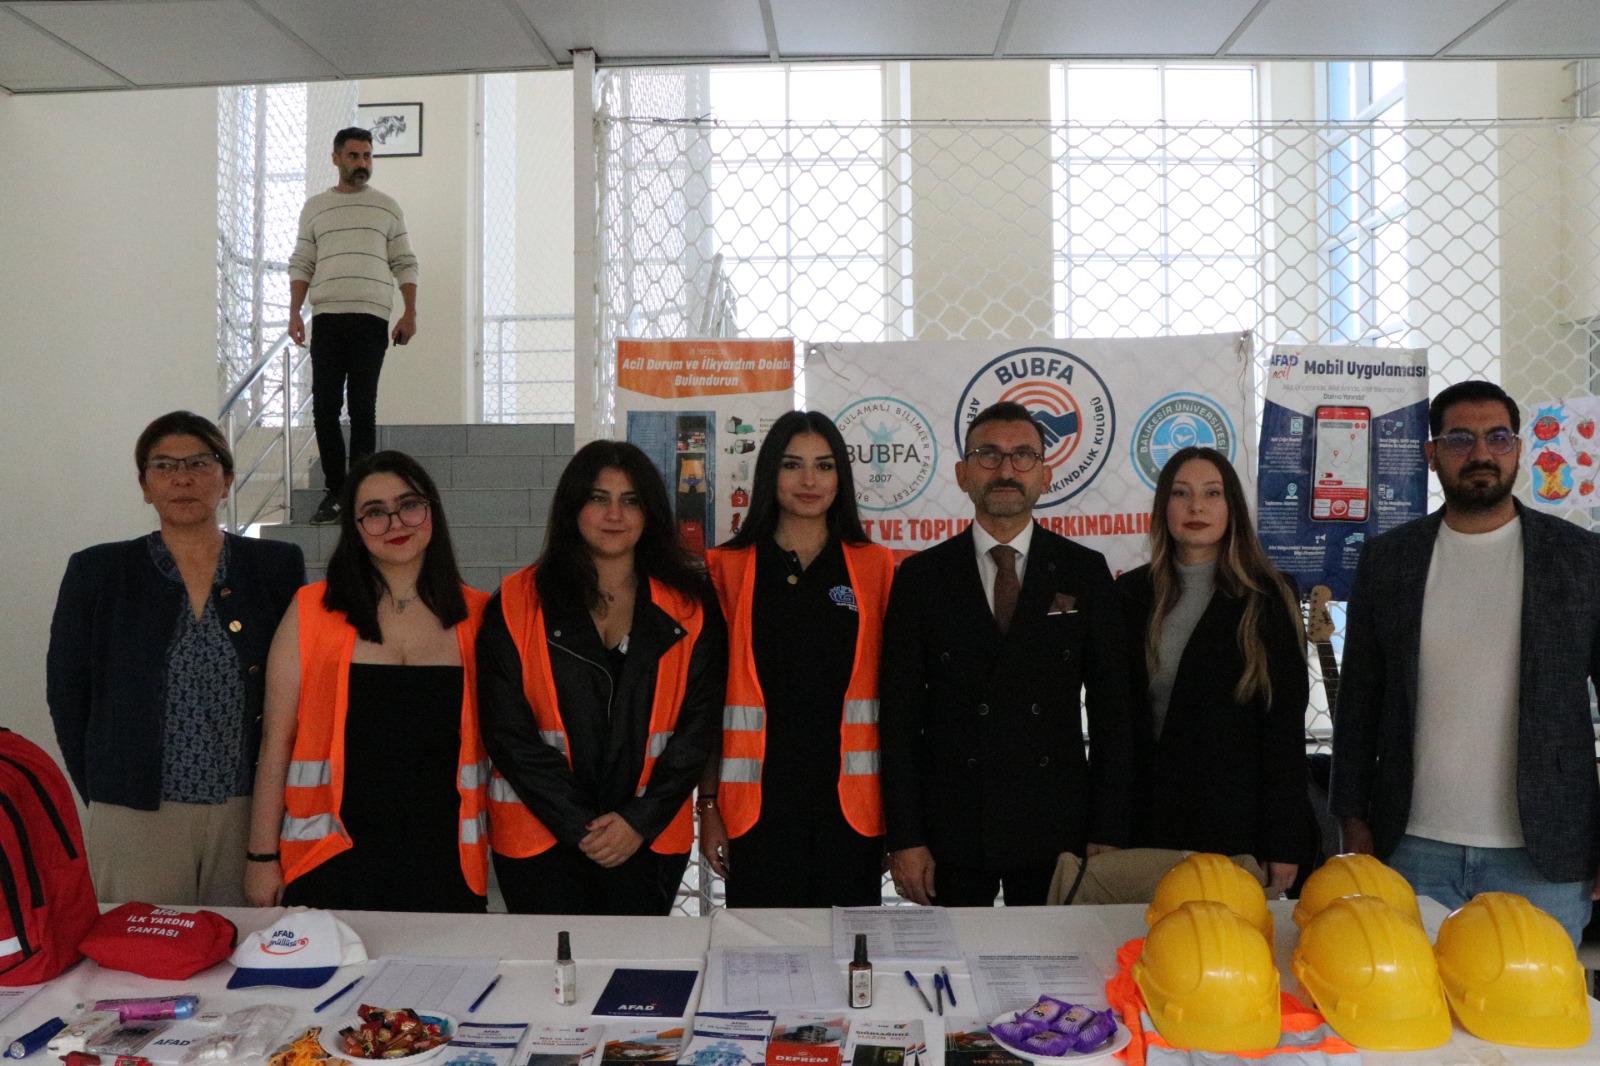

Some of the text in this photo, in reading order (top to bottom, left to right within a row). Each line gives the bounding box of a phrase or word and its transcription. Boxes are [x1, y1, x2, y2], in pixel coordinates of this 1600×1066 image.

[622, 357, 643, 370] Acil
[646, 358, 682, 370] Durum
[686, 359, 698, 370] ve
[702, 356, 755, 372] İlkyardım
[994, 358, 1074, 386] BUBFA
[1304, 359, 1426, 380] Mobil Uygulaması
[674, 375, 739, 386] Bulundurun
[839, 404, 890, 432] GULAMALI
[1140, 401, 1228, 453] BALIKESİR ÜNİVERSİTESİ
[1046, 396, 1105, 494] RKINDALIK KULÜBÜ
[846, 444, 921, 464] BUBFA
[869, 474, 892, 483] 2007
[878, 519, 904, 541] VE
[907, 519, 971, 541] TOPLU
[150, 917, 195, 928] YARDIM
[127, 926, 179, 937] ÇANTASI
[272, 930, 294, 939] AFAD
[153, 1038, 190, 1046] AFAD
[775, 1055, 829, 1063] DEPREM
